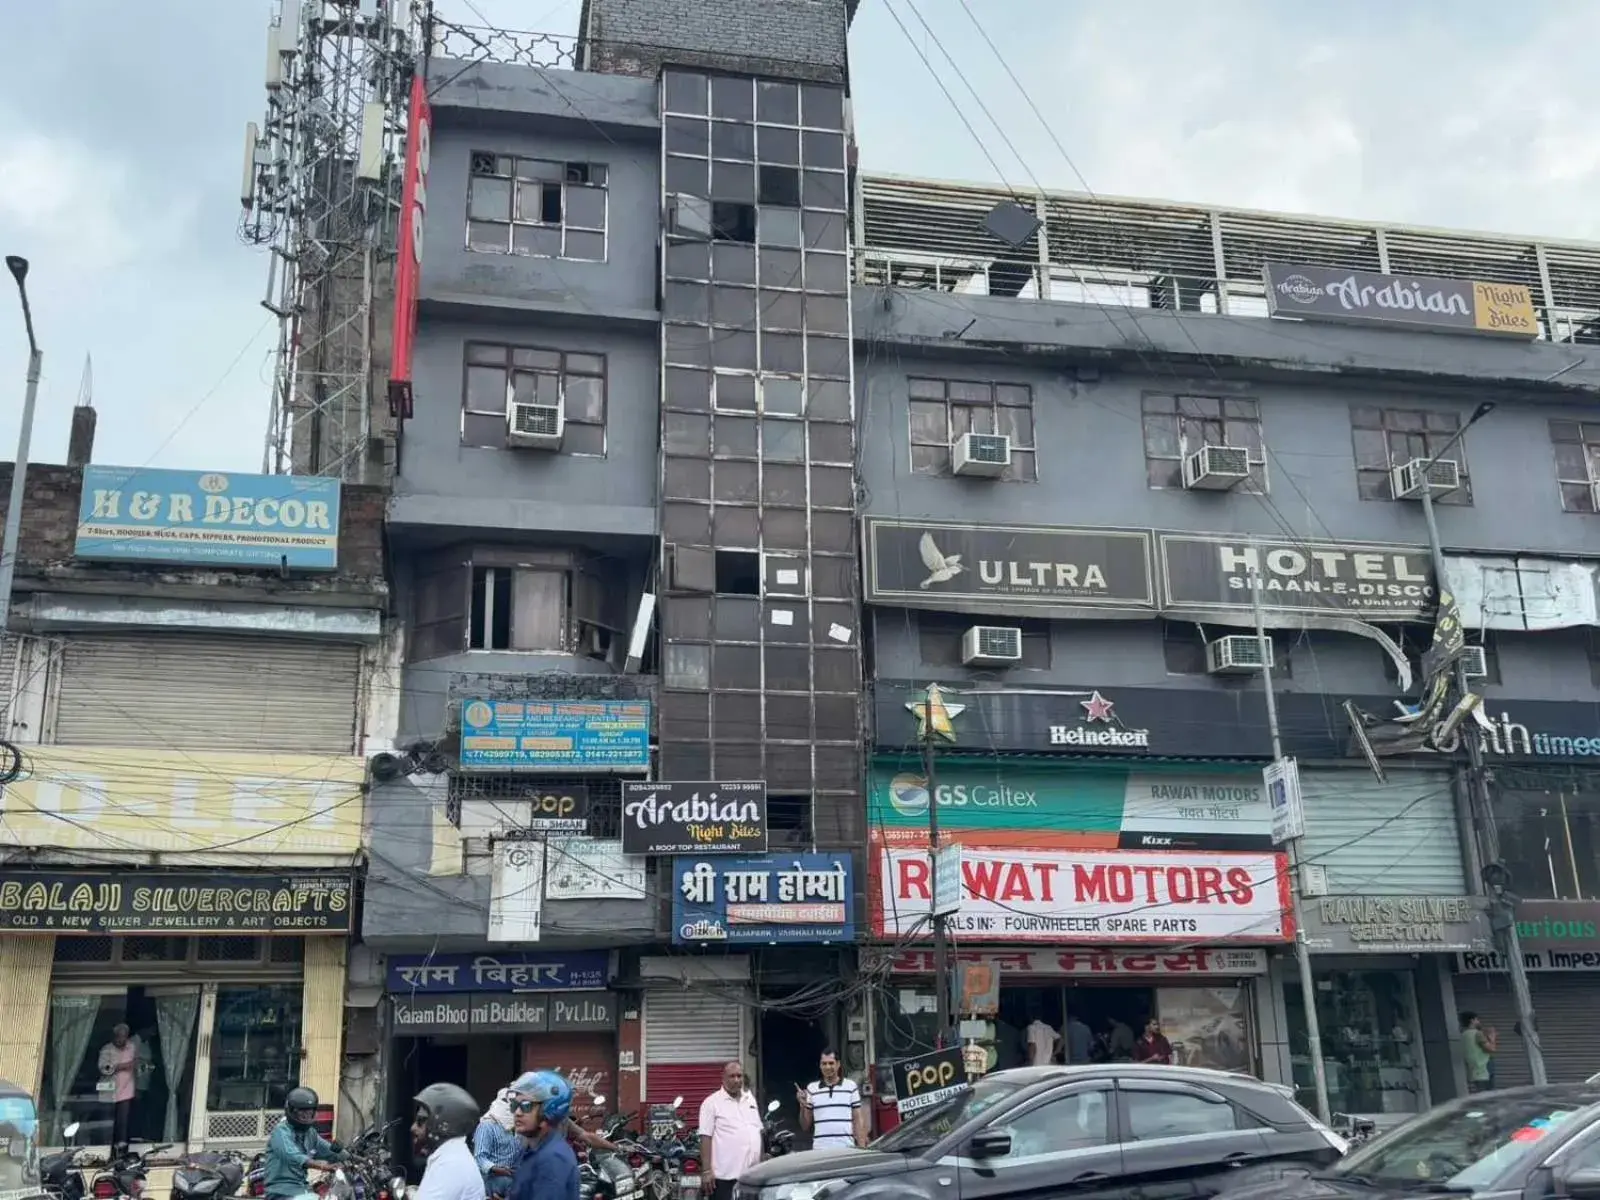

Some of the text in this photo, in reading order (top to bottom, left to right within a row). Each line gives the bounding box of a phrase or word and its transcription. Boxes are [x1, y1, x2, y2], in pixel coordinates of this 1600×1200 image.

[1326, 276, 1470, 315] Arabian
[1477, 284, 1525, 309] Night
[1488, 306, 1530, 328] Bites
[92, 489, 330, 529] H & R DECOR
[236, 534, 289, 543] PROMOTIONAL
[291, 536, 326, 545] PRODUCT
[979, 560, 1108, 588] ULTRA
[1220, 546, 1425, 581] HOTEL
[1364, 598, 1390, 606] Unit
[1050, 726, 1149, 746] Heineken
[1533, 733, 1600, 755] times
[935, 784, 1038, 807] GS Caltex
[1151, 785, 1260, 801] RAWAT MOTORS
[625, 792, 761, 829] Arabian
[687, 822, 762, 843] Night Bites
[1142, 836, 1171, 845] Kixx
[681, 862, 717, 902] श्री
[723, 870, 770, 901] राम
[777, 861, 847, 901] होम्यो
[898, 859, 1059, 902] RWAT
[1073, 864, 1253, 905] MOTORS
[0, 882, 347, 912] BALAJI SILVERCRAFTS
[12, 915, 328, 926] OLD & NEW SILVER JEWELLERY & ART OBJECTS
[1400, 898, 1471, 923] SILVER
[816, 929, 843, 937] NAGAR
[1005, 917, 1099, 931] FOURWHEELER
[1107, 919, 1149, 931] SPARE
[1153, 919, 1197, 931] PARTS
[1350, 923, 1444, 941] SELECTION
[892, 950, 1036, 971] रात
[396, 957, 565, 988] राम बिहार
[394, 1005, 435, 1025] Karam
[490, 1001, 544, 1024] Builder
[907, 1061, 954, 1096] pop
[901, 1095, 931, 1109] HOTEL
